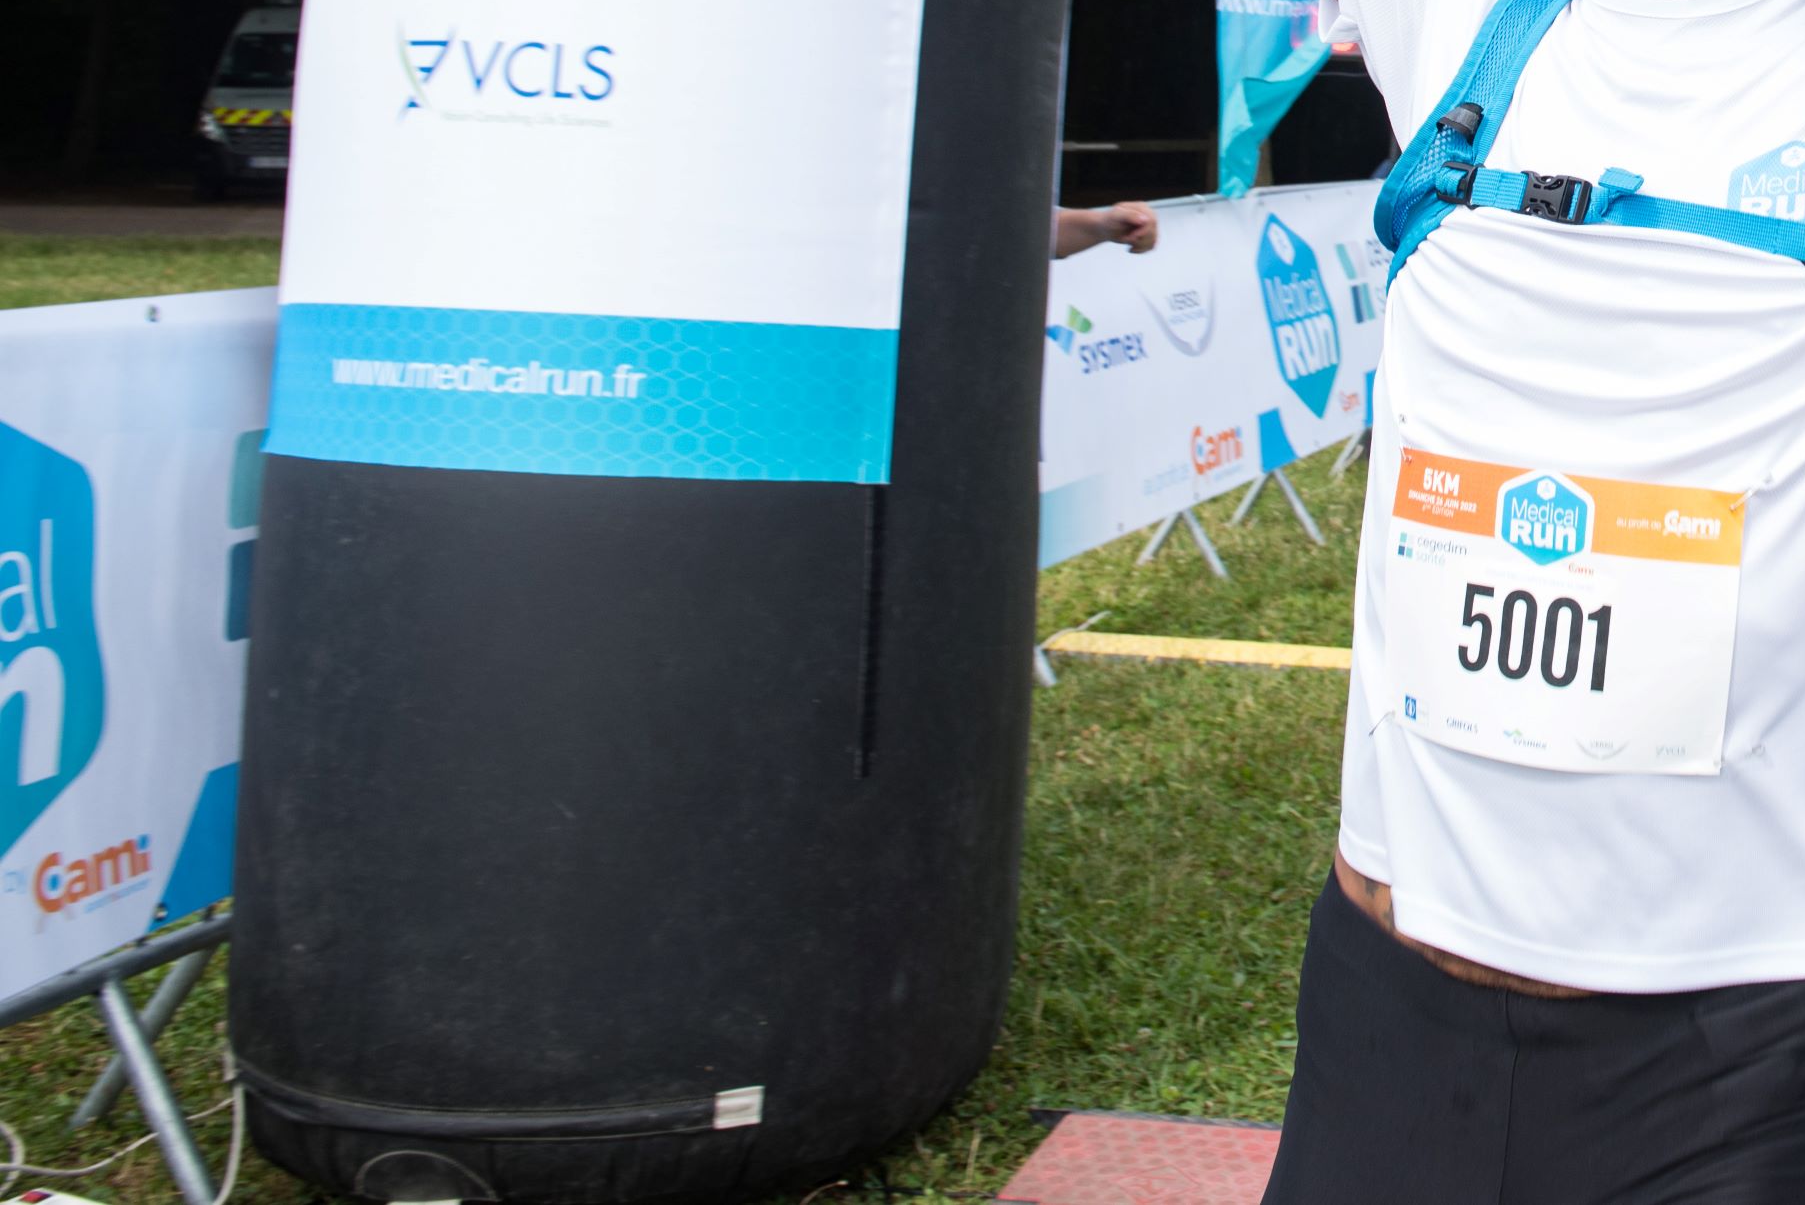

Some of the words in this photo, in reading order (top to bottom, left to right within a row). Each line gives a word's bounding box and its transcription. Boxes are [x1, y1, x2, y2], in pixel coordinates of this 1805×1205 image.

[460, 40, 615, 102] VCLS
[1264, 269, 1326, 323] Medical
[1078, 332, 1149, 374] sysmex
[1276, 312, 1340, 382] Run
[332, 358, 647, 398] www.medicalrun.fr
[1190, 424, 1243, 476] Cami
[1511, 496, 1579, 528] Medical
[1664, 509, 1721, 540] Cami
[1416, 535, 1468, 557] cegedim
[1509, 517, 1578, 555] Run
[1415, 552, 1447, 568] santé
[1457, 582, 1612, 693] 5001
[33, 834, 152, 913] Cami
